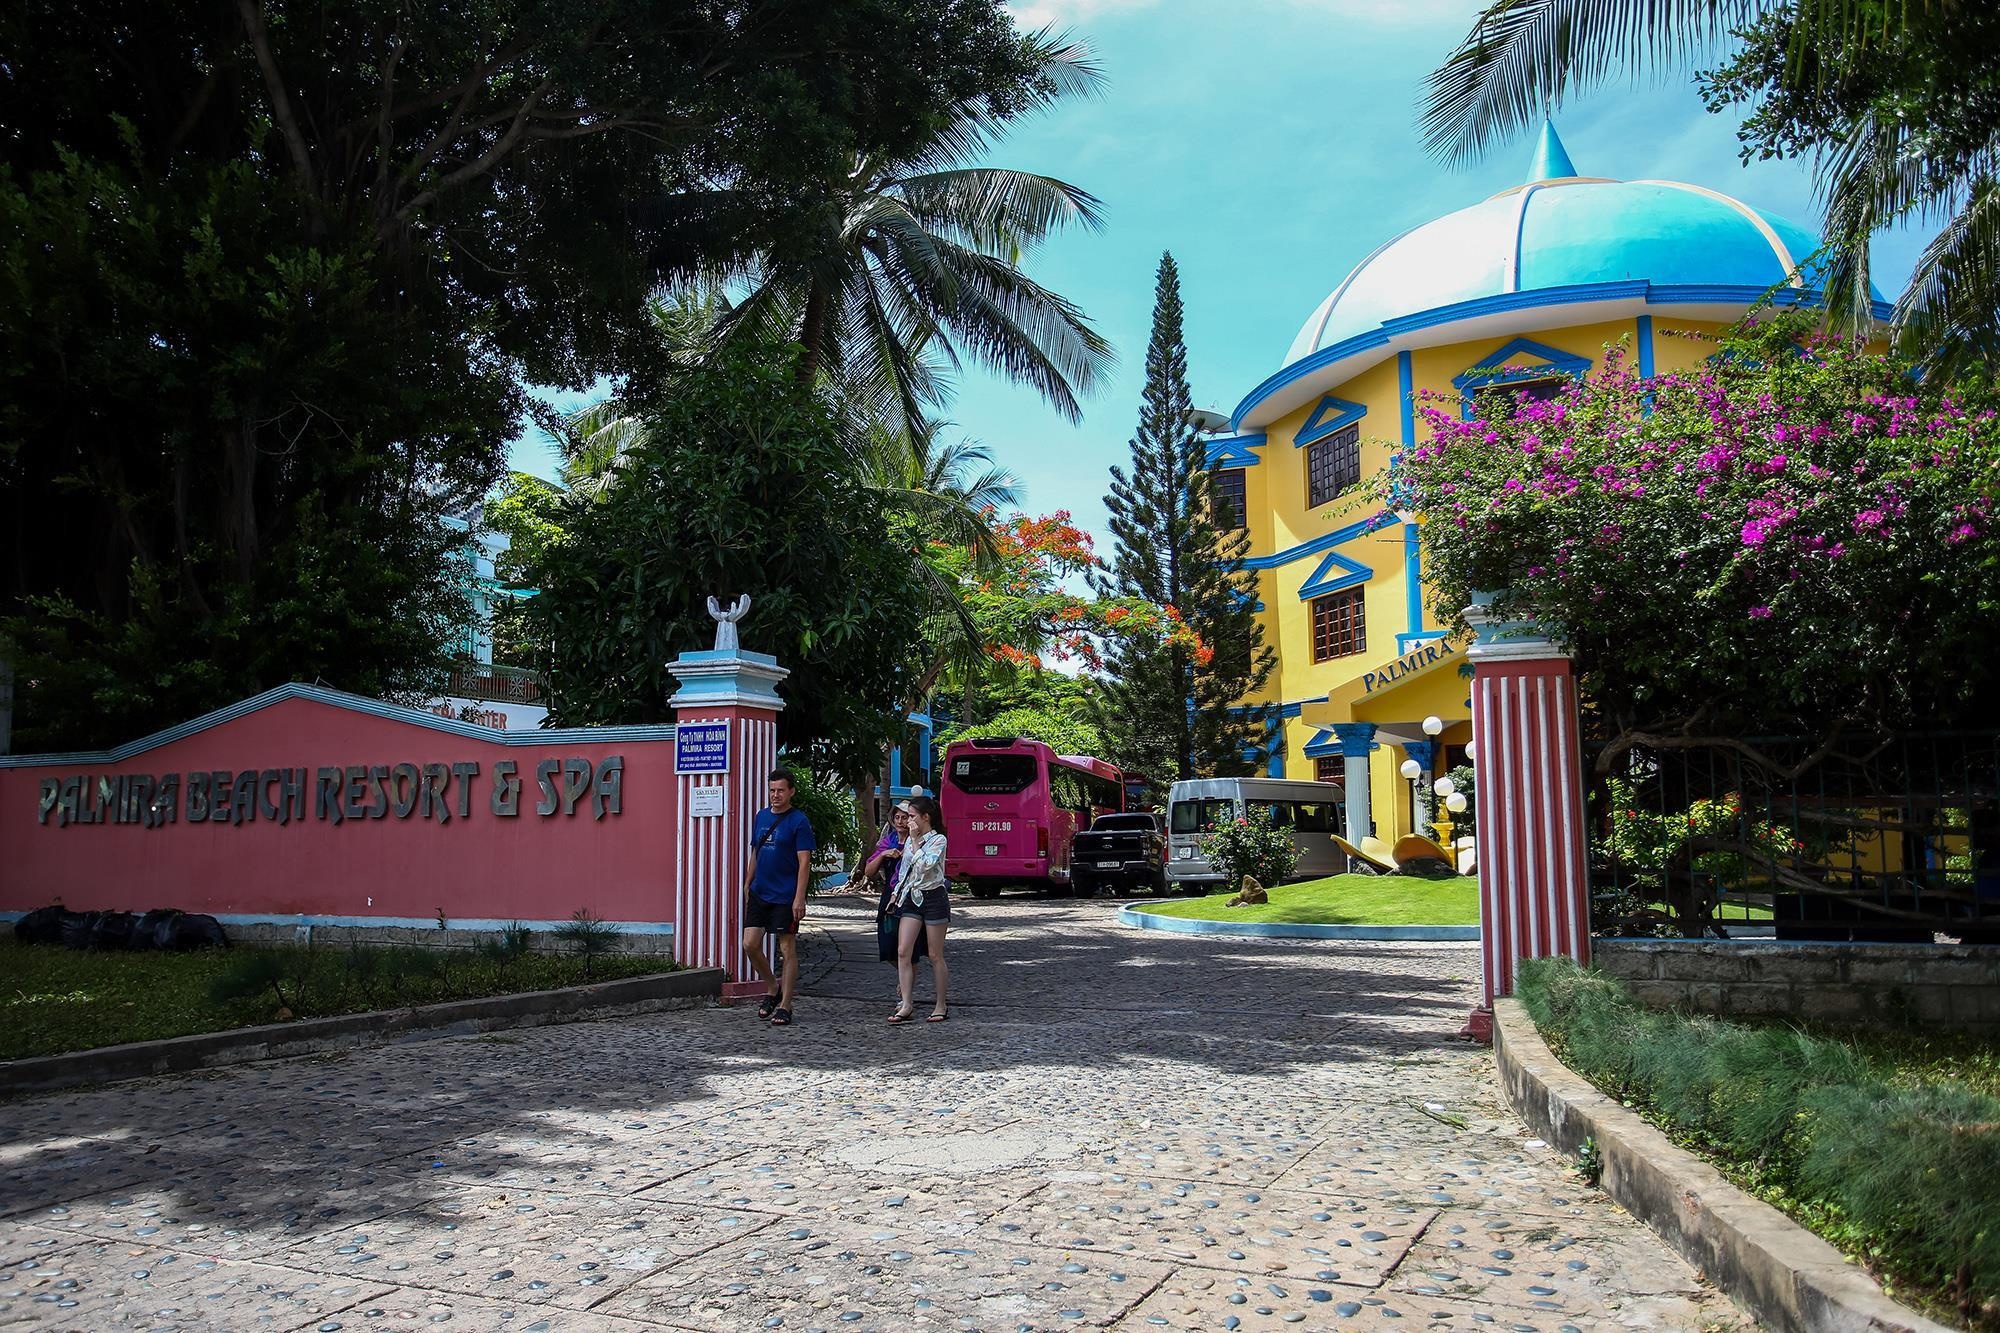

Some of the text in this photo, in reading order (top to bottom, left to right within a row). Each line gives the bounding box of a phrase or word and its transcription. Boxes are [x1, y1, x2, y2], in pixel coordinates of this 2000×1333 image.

[1362, 639, 1454, 693] PALMIRA
[682, 743, 724, 752] PALMIRA RESORT
[38, 755, 625, 827] PALMIRA BEACH RESORT & SPA
